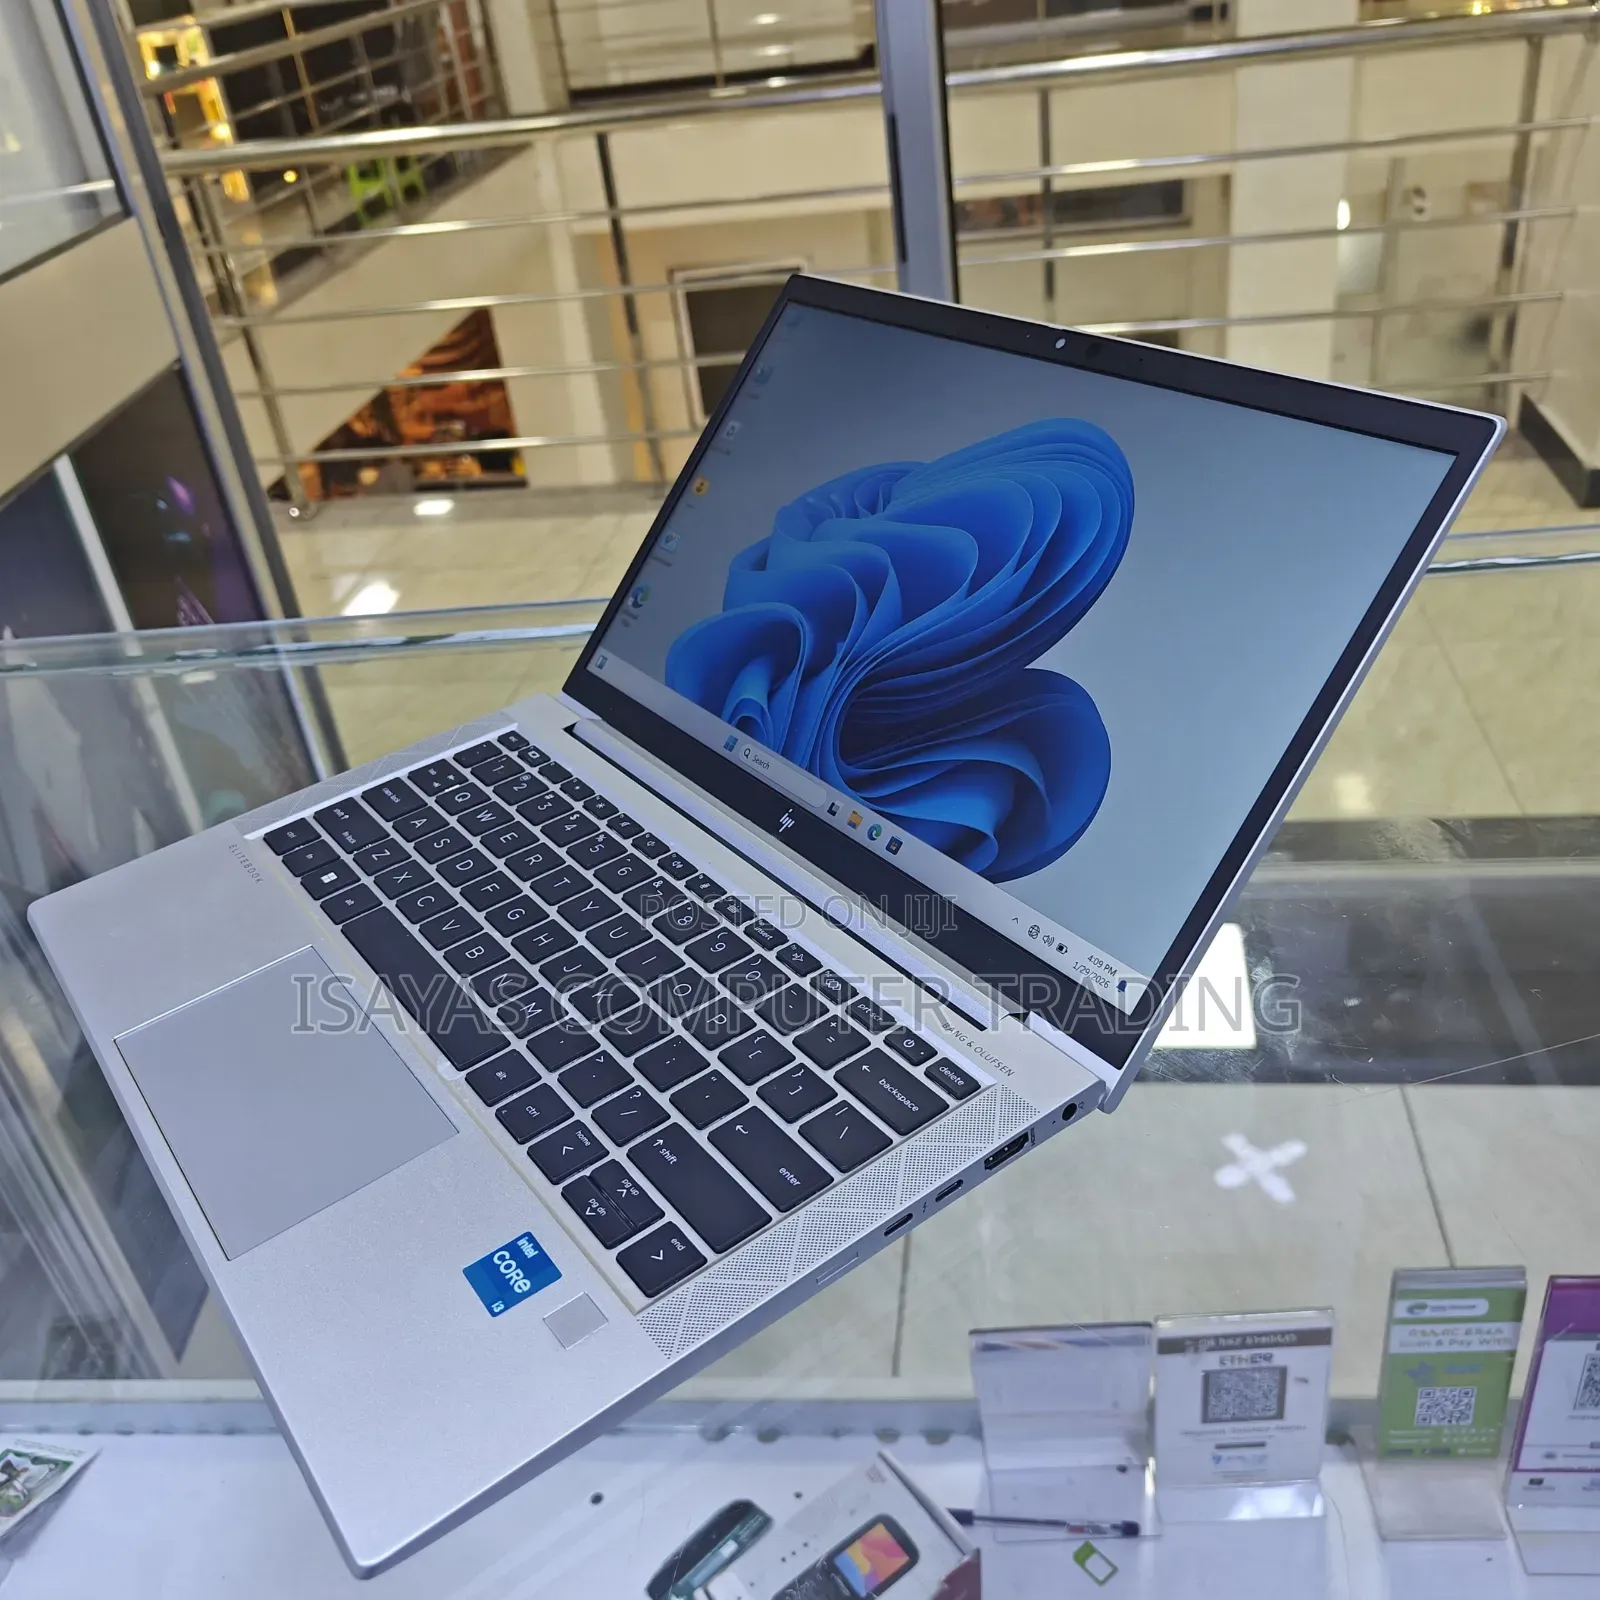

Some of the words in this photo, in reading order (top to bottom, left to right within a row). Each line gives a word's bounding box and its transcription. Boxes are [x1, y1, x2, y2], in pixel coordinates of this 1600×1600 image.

[752, 754, 770, 770] Search
[512, 783, 528, 792] 2
[454, 792, 471, 802] Q
[538, 802, 552, 810] 3
[476, 810, 496, 822] W
[410, 818, 428, 828] A
[564, 824, 578, 832] 4
[434, 838, 450, 848] S
[500, 832, 518, 844] E
[590, 844, 604, 853] 5
[372, 849, 390, 861] Z
[524, 854, 543, 866] R
[228, 844, 265, 885] ELITEBOOK
[456, 860, 474, 870] D
[618, 866, 632, 876] 6
[393, 871, 412, 884] X
[554, 876, 570, 888] T
[480, 882, 500, 892] F
[648, 890, 664, 898] 7
[416, 896, 435, 907] C
[581, 900, 600, 912] Y
[507, 908, 526, 920] G
[442, 919, 460, 930] V
[678, 916, 692, 926] 8
[609, 926, 630, 939] U
[532, 932, 554, 946] H
[465, 946, 484, 958] B
[710, 942, 726, 952] 9
[562, 964, 582, 972] J
[1087, 955, 1104, 969] 4:09
[1103, 964, 1118, 977] PM
[492, 973, 514, 988] N
[1072, 961, 1111, 989] 1/29/2026
[592, 988, 614, 1004] K
[520, 1002, 543, 1018] M
[706, 1014, 727, 1024] P
[624, 1020, 641, 1035] L
[942, 1022, 968, 1042] BANG
[974, 1046, 1016, 1076] OLUFSEN
[496, 1070, 508, 1080] alt
[939, 1065, 965, 1087] delete
[878, 1078, 919, 1112] backspace
[526, 1105, 540, 1118] ctrl
[576, 1130, 591, 1147] home
[659, 1146, 678, 1165] shift
[778, 1166, 801, 1187] enter
[622, 1178, 632, 1188] pg
[630, 1186, 640, 1196] up
[588, 1198, 600, 1208] pg
[596, 1205, 606, 1216] dn
[516, 1236, 540, 1259] intel
[670, 1238, 686, 1251] end
